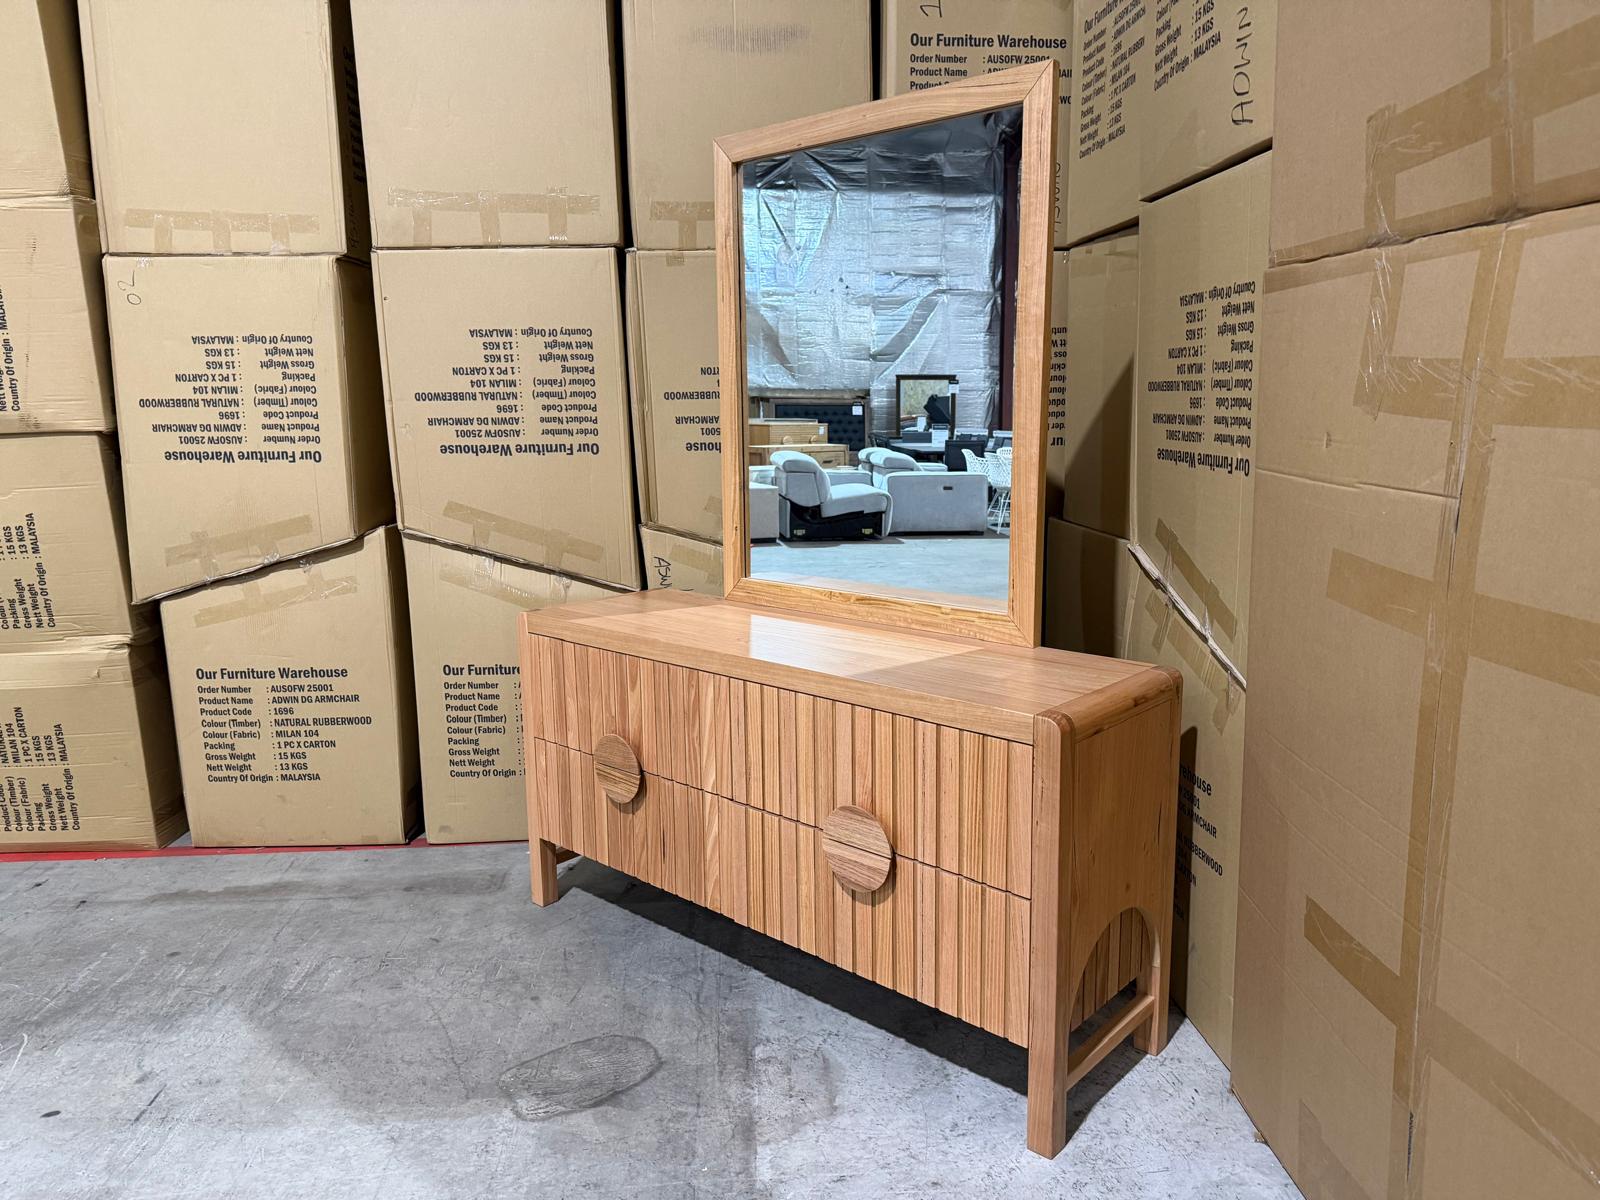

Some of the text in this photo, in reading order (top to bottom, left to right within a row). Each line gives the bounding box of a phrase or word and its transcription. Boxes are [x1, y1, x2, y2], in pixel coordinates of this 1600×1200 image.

[1195, 10, 1201, 22] 15
[1194, 28, 1201, 41] 13
[910, 33, 1067, 48] Our Furniture Warehouse
[1194, 31, 1221, 58] MALAYSIA
[910, 54, 933, 63] Order
[935, 55, 967, 63] Number
[987, 55, 1022, 64] AUSOFW
[910, 68, 967, 77] Product Name
[469, 327, 592, 337] Country Of Origin MALAYSIA
[2, 338, 13, 364] Origin
[6, 366, 15, 376] Of
[1181, 381, 1202, 391] NATURAL
[1211, 377, 1233, 391] (Timber)
[1233, 379, 1252, 390] Colour
[8, 378, 20, 411] Country
[139, 397, 317, 407] Colour (Timber) NATURAL RUBBERWOOD
[263, 411, 284, 419] Code
[286, 411, 318, 419] Product
[675, 415, 719, 424] ARMCHAIR
[427, 416, 597, 426] Product Name ADWIN DG ARMCHAIR
[152, 423, 319, 432] Product Name ADWIN DG ARMCHAIR
[576, 428, 598, 437] Order
[484, 429, 520, 437] AUSOFW
[541, 429, 573, 437] Number
[178, 436, 320, 444] Order Number AUSOFW 25001
[1214, 433, 1234, 446] Number
[1235, 434, 1251, 448] Order
[440, 443, 599, 456] Our Furniture Warehouse
[685, 442, 721, 453] house
[164, 451, 322, 463] Our Furniture Warehouse
[1157, 448, 1250, 477] Our Furniture Warehouse
[3, 526, 16, 554] 15 KGS
[15, 526, 28, 554] 13 KGS
[26, 513, 55, 627] Country Of Origin MALAYSIA
[196, 668, 348, 680] Our Furniture Warehouse
[443, 665, 464, 675] Our
[221, 685, 251, 693] Number
[307, 684, 333, 692] 25001
[199, 697, 229, 705] Product
[315, 695, 360, 703] ARMCHAIR
[200, 708, 231, 716] Product
[229, 719, 261, 728] (Timber)
[274, 718, 311, 726] NATURAL
[313, 717, 372, 725] RUBBERWOOD
[447, 715, 507, 724] Colour (Timber)
[203, 731, 228, 739] Colour
[230, 730, 261, 740] (Fabric)
[276, 730, 301, 738] MILAN
[475, 726, 506, 735] (Fabric)
[5, 723, 21, 763] MILAN 104
[204, 742, 235, 751] Packing
[448, 738, 479, 746] Packing
[229, 752, 256, 762] Weight
[472, 748, 500, 756] Weight
[225, 764, 252, 772] Weight
[468, 759, 495, 767] Weight
[54, 724, 80, 830] Country Of Origin MALAYSIA
[208, 775, 238, 783] Country
[250, 774, 273, 783] Origin
[450, 770, 480, 778] Country
[493, 769, 516, 777] Origin
